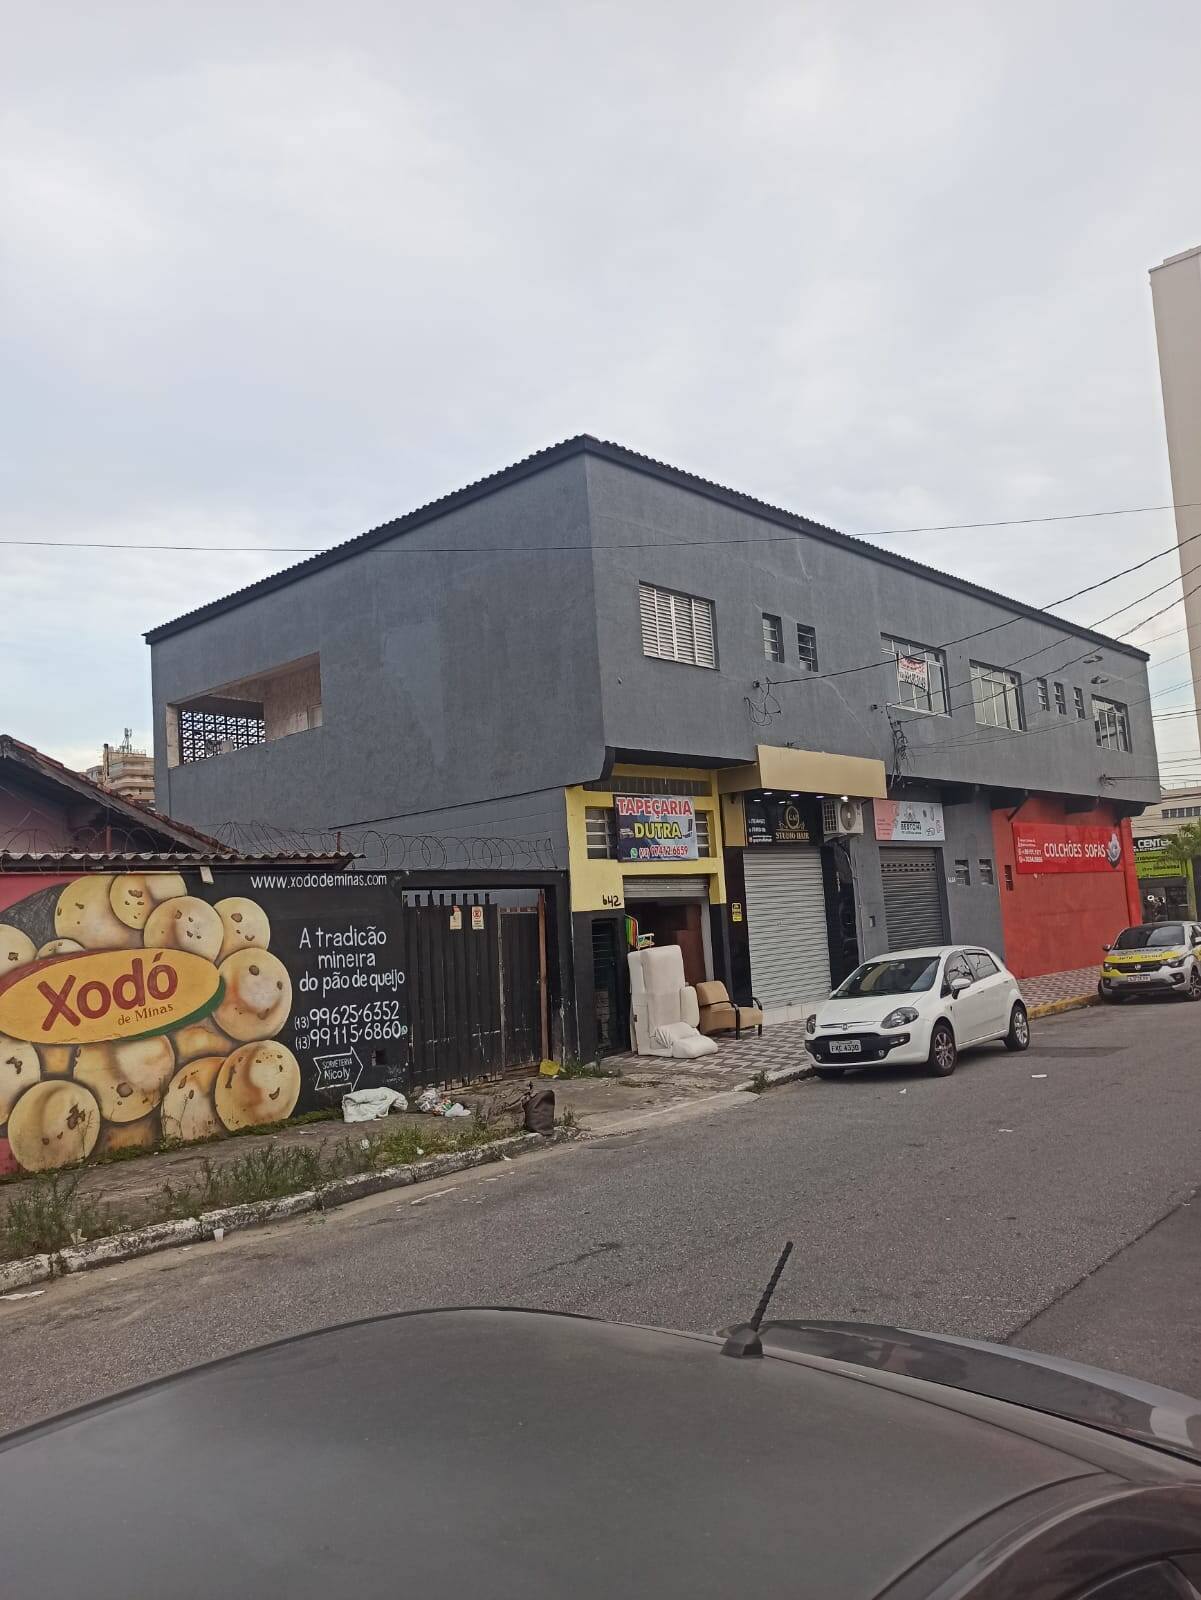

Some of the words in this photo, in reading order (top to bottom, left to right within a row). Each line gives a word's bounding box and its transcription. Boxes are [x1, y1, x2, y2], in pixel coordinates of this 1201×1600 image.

[616, 797, 693, 819] TAPEÇARIA
[633, 821, 682, 839] DUTRA
[775, 831, 796, 840] STUDIO
[1043, 840, 1083, 858] COLCHÕES
[1084, 841, 1106, 858] SOFÁS
[250, 873, 388, 889] www.xododeminas.com
[602, 894, 622, 908] 642
[299, 927, 312, 949] A
[318, 950, 376, 970] mineira
[37, 952, 179, 1032] Xodó
[299, 970, 319, 992] do
[322, 971, 350, 999] pão
[351, 969, 368, 988] de
[369, 968, 406, 993] queijo
[117, 1014, 131, 1026] de
[134, 1003, 174, 1023] Minas
[294, 1016, 310, 1031] (13)
[295, 1037, 311, 1051] (13)
[322, 1058, 353, 1070] SORVETERIA
[324, 1067, 351, 1081] Nicoly
